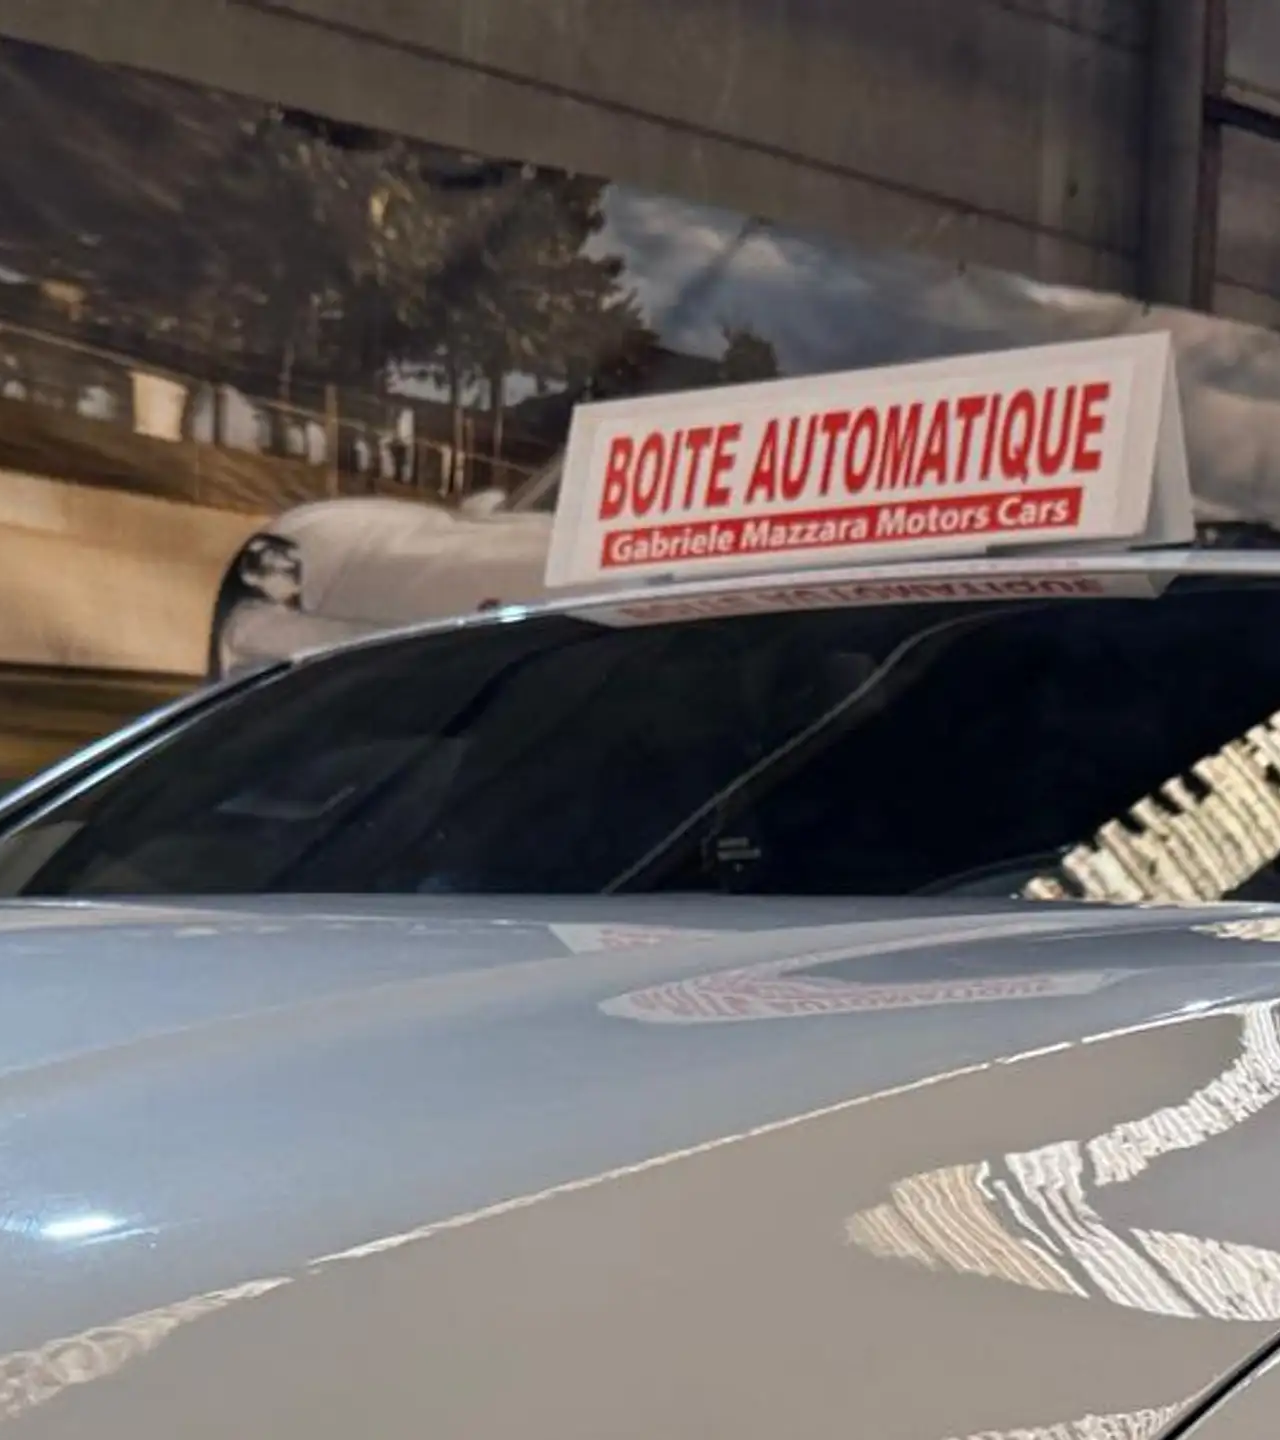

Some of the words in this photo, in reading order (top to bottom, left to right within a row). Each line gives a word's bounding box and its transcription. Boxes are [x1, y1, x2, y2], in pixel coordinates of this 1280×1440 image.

[599, 423, 741, 521] BOITE
[745, 382, 1111, 503] AUTOMATIQUE
[611, 527, 734, 564] Gabriele
[740, 512, 867, 551] Mazzara
[875, 500, 990, 537] Motors
[997, 496, 1069, 526] Cars
